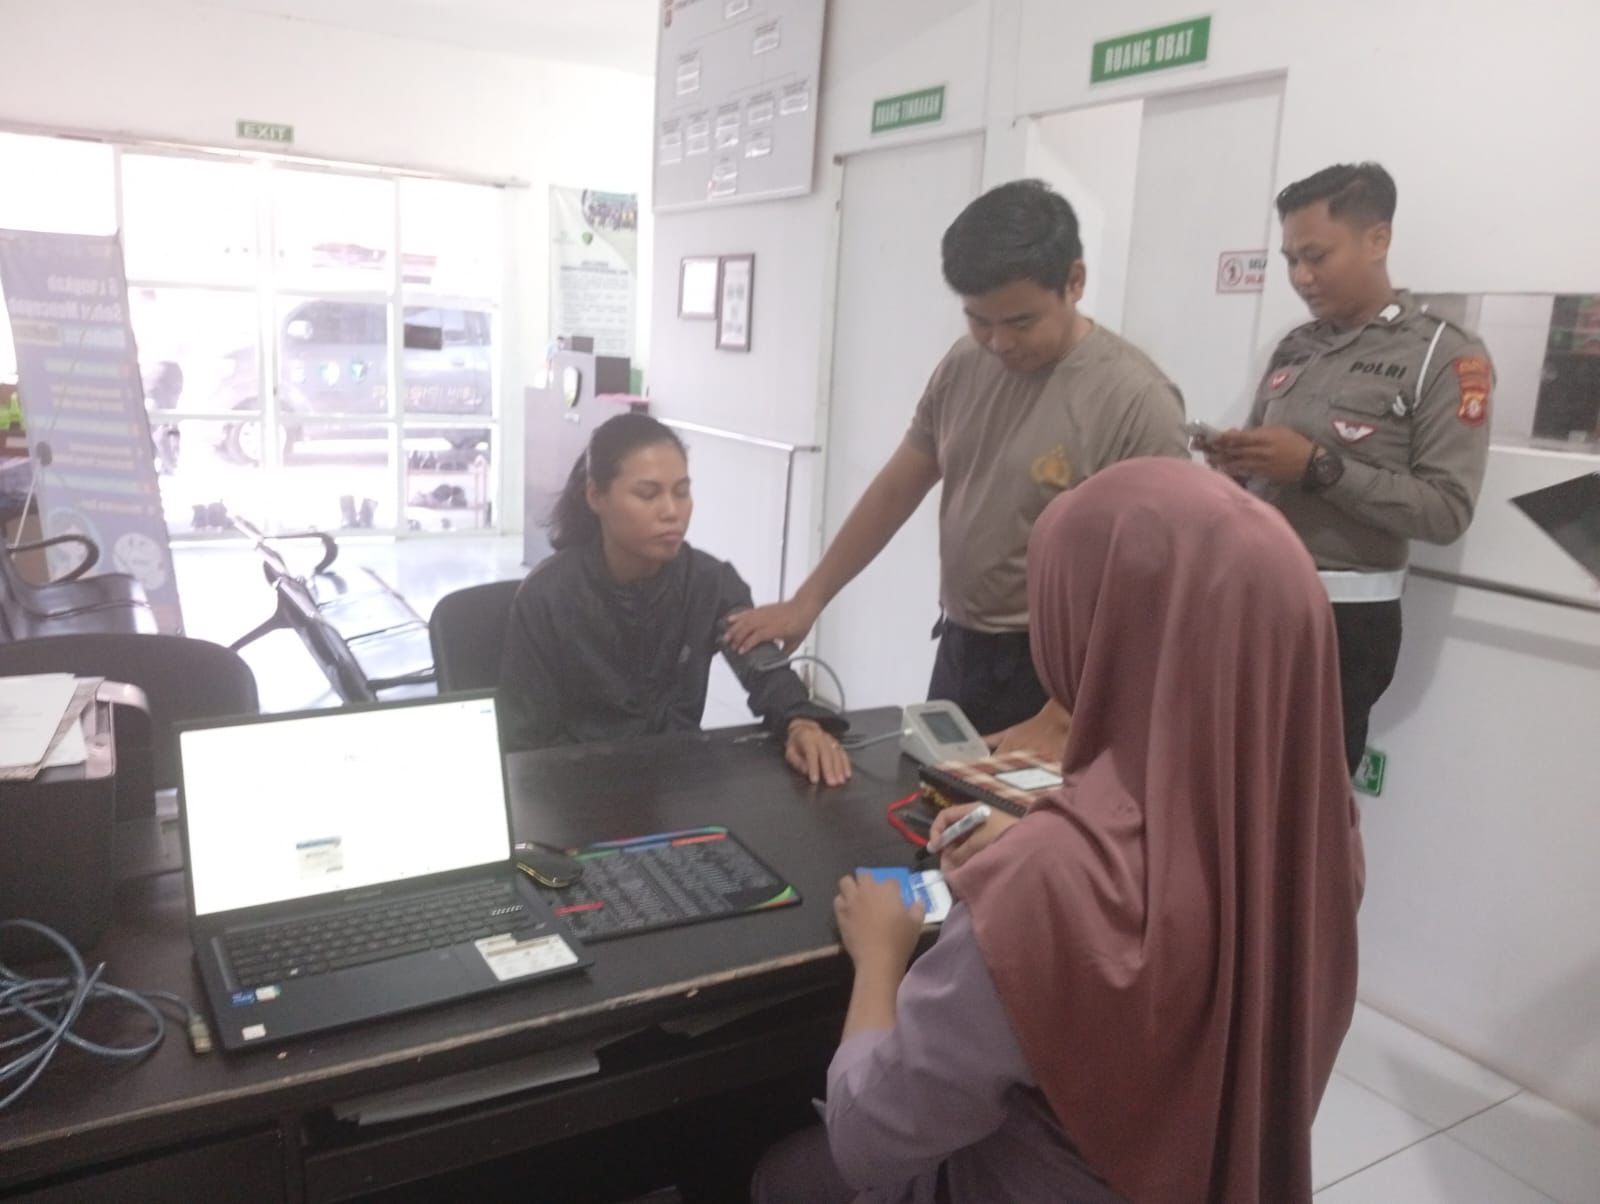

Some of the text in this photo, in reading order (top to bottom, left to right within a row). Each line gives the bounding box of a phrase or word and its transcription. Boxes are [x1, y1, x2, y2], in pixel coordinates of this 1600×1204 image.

[1104, 27, 1195, 74] RUANG OBAT
[244, 123, 288, 142] EXIT
[1350, 361, 1407, 380] POLRI
